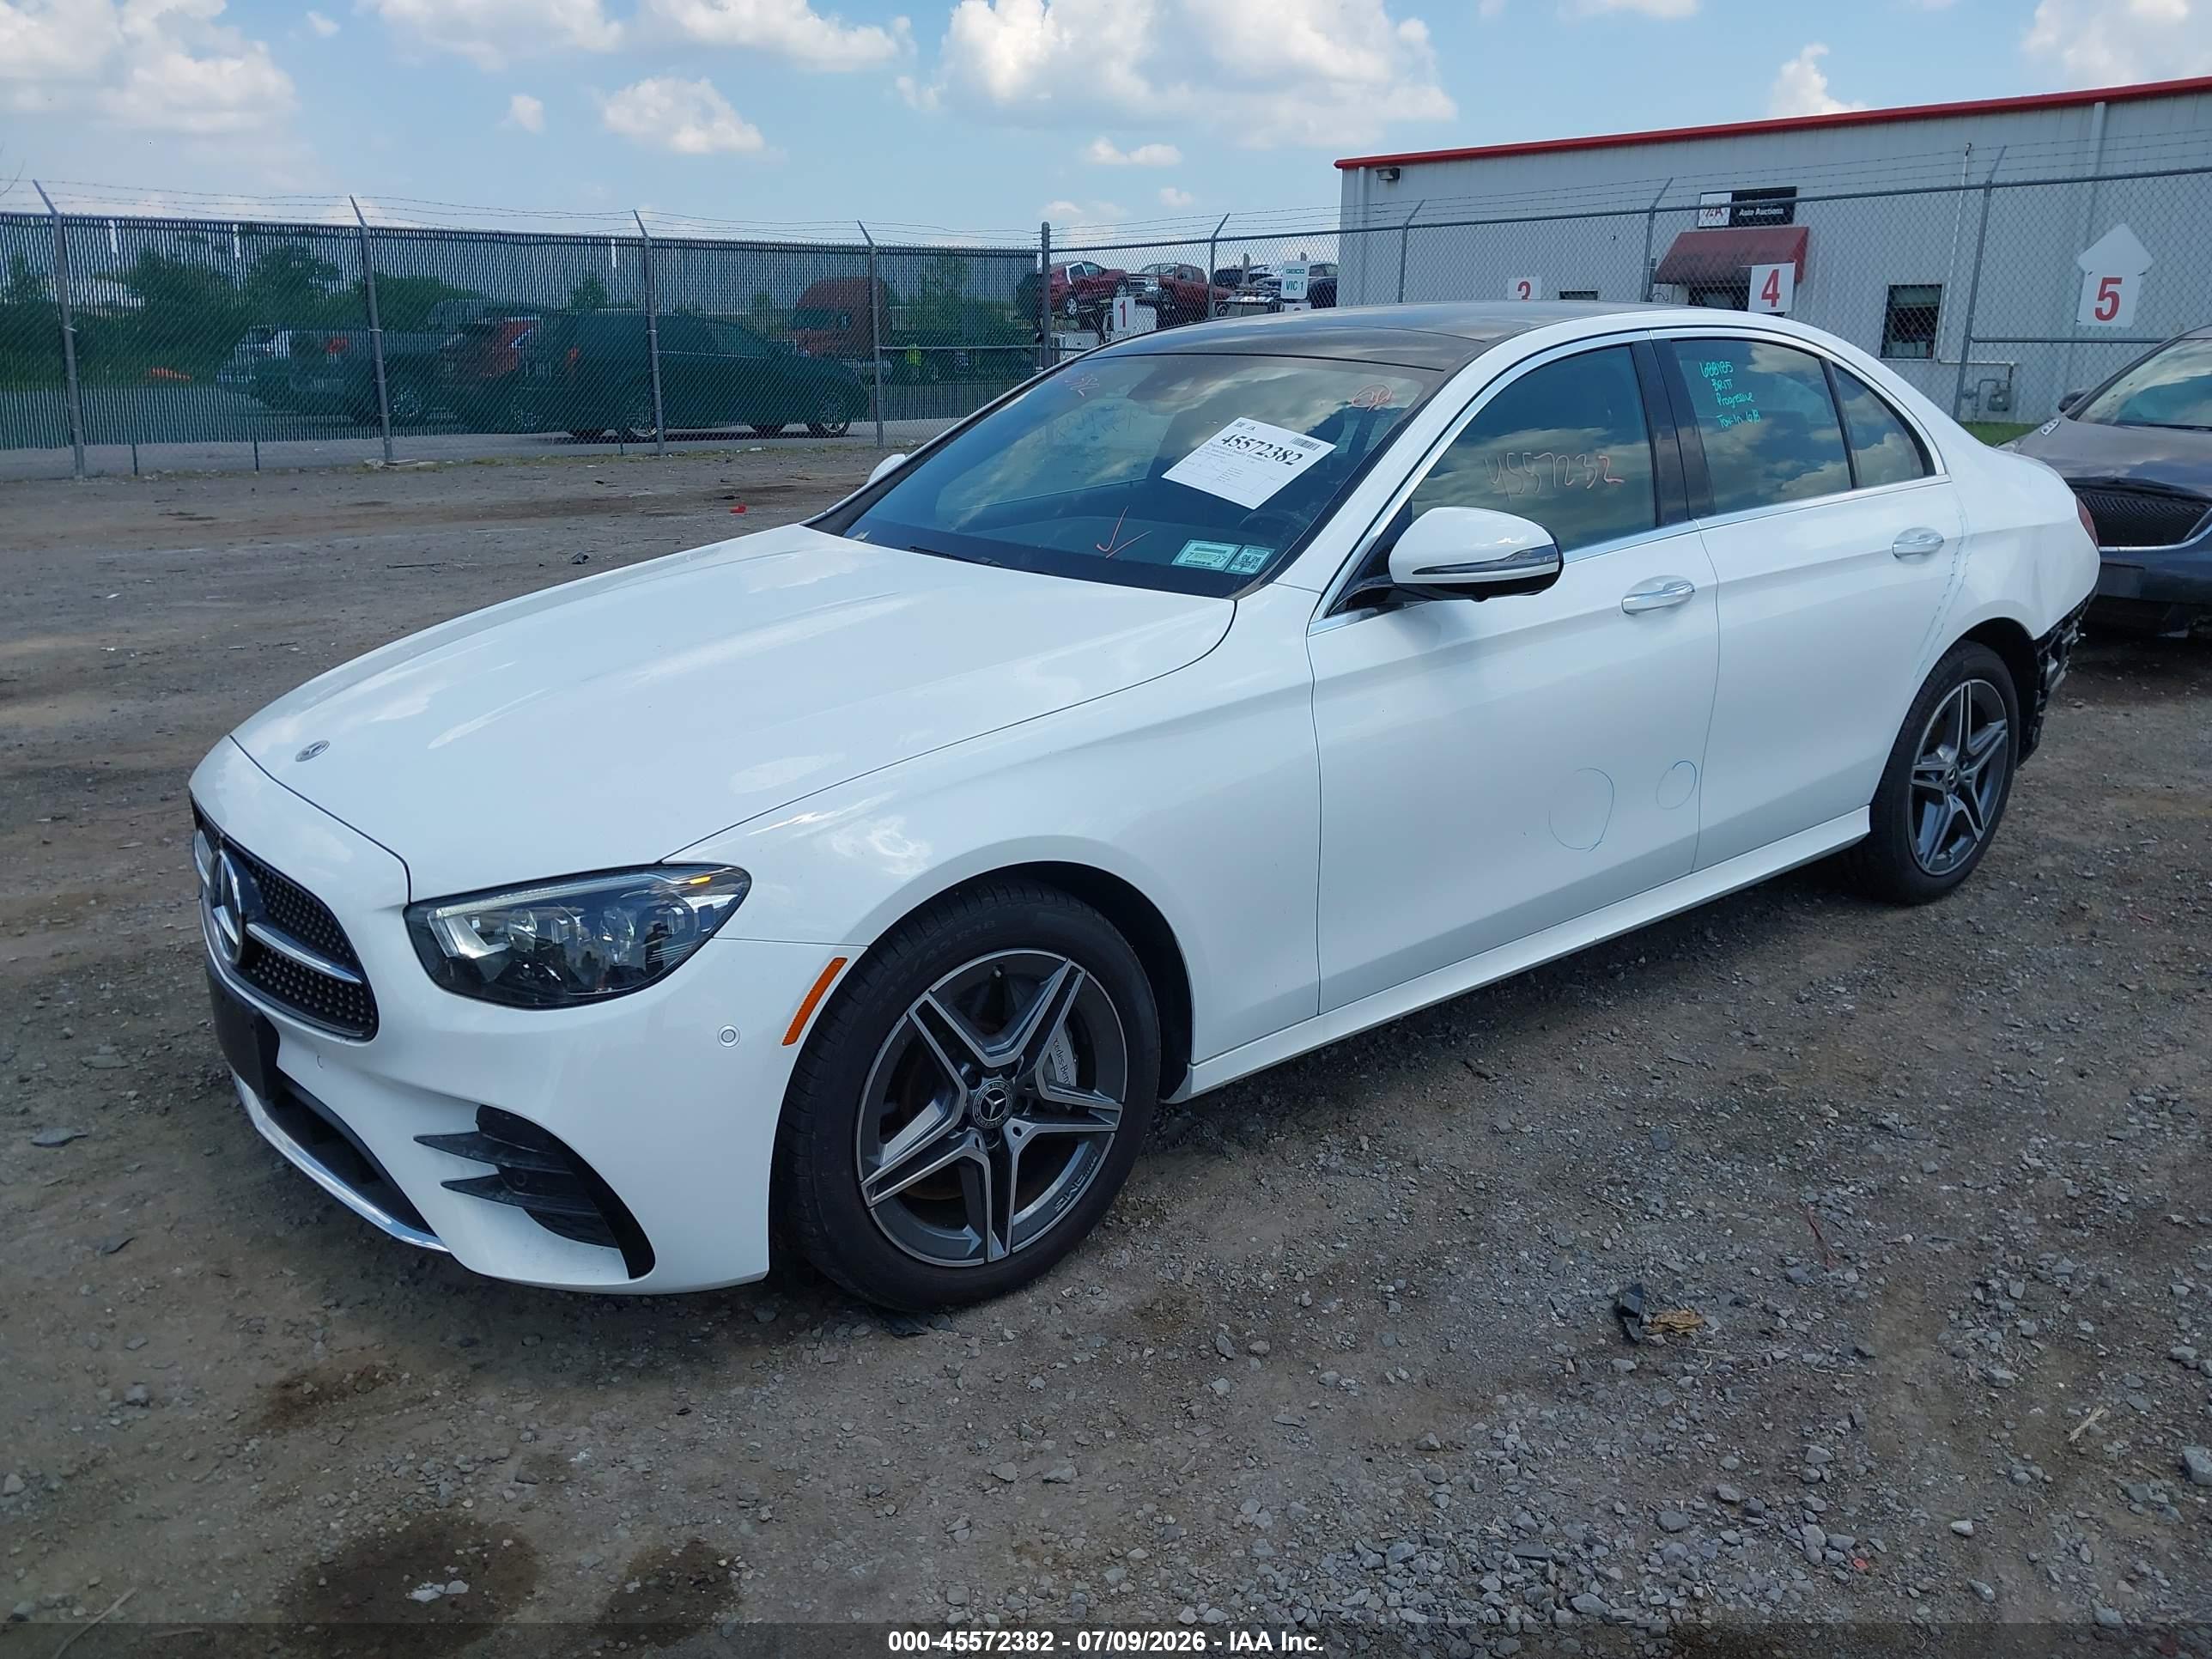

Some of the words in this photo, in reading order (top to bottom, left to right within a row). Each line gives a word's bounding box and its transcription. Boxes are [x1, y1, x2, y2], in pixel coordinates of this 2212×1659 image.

[1285, 280, 1298, 291] VIC
[1300, 281, 1304, 291] 1
[1761, 268, 1780, 307] 4
[2094, 276, 2123, 321] 5
[1119, 300, 1127, 328] 1
[1221, 434, 1304, 466] 45572382
